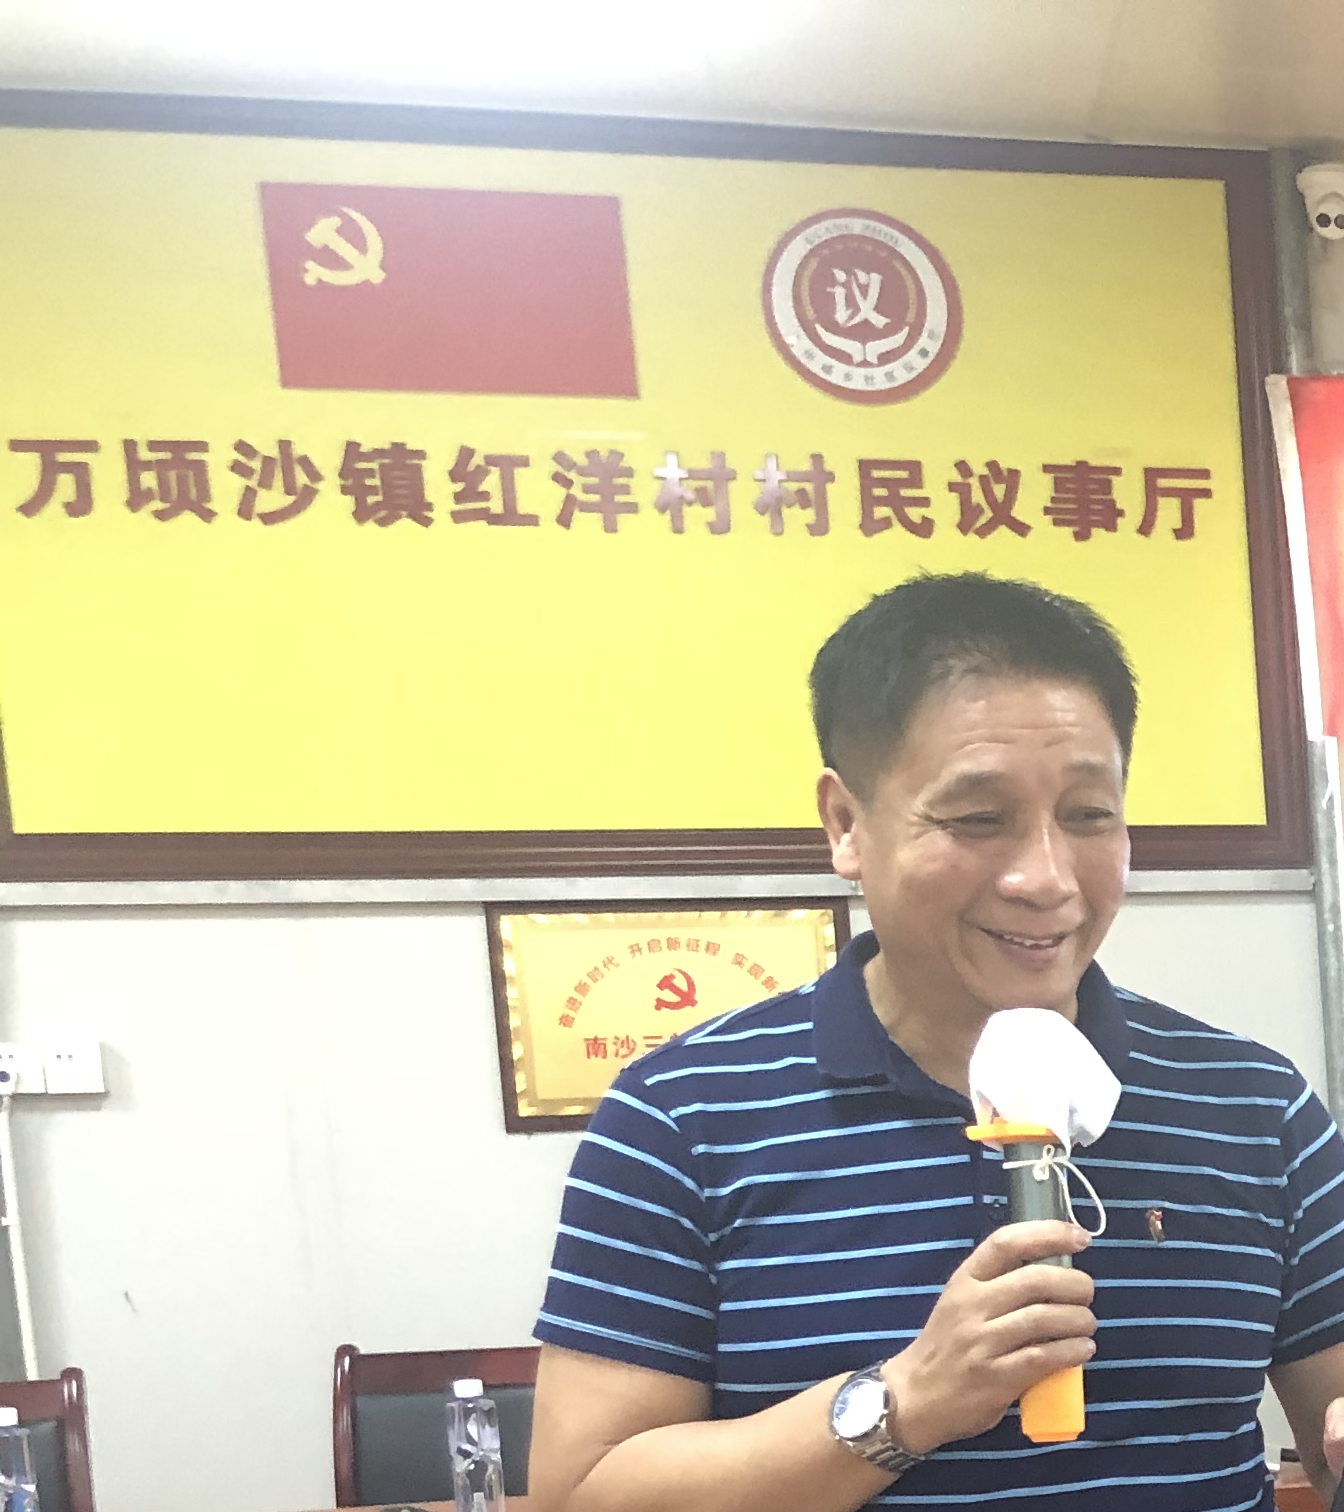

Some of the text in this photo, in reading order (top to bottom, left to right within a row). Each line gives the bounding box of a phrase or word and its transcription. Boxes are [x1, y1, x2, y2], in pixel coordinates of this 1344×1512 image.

[826, 267, 891, 328] 议
[8, 438, 1214, 542] 万顷沙镇红洋村村民议事厅
[627, 936, 721, 959] 开启新征程
[730, 952, 783, 994] 实现新
[583, 1033, 678, 1060] 南沙三
